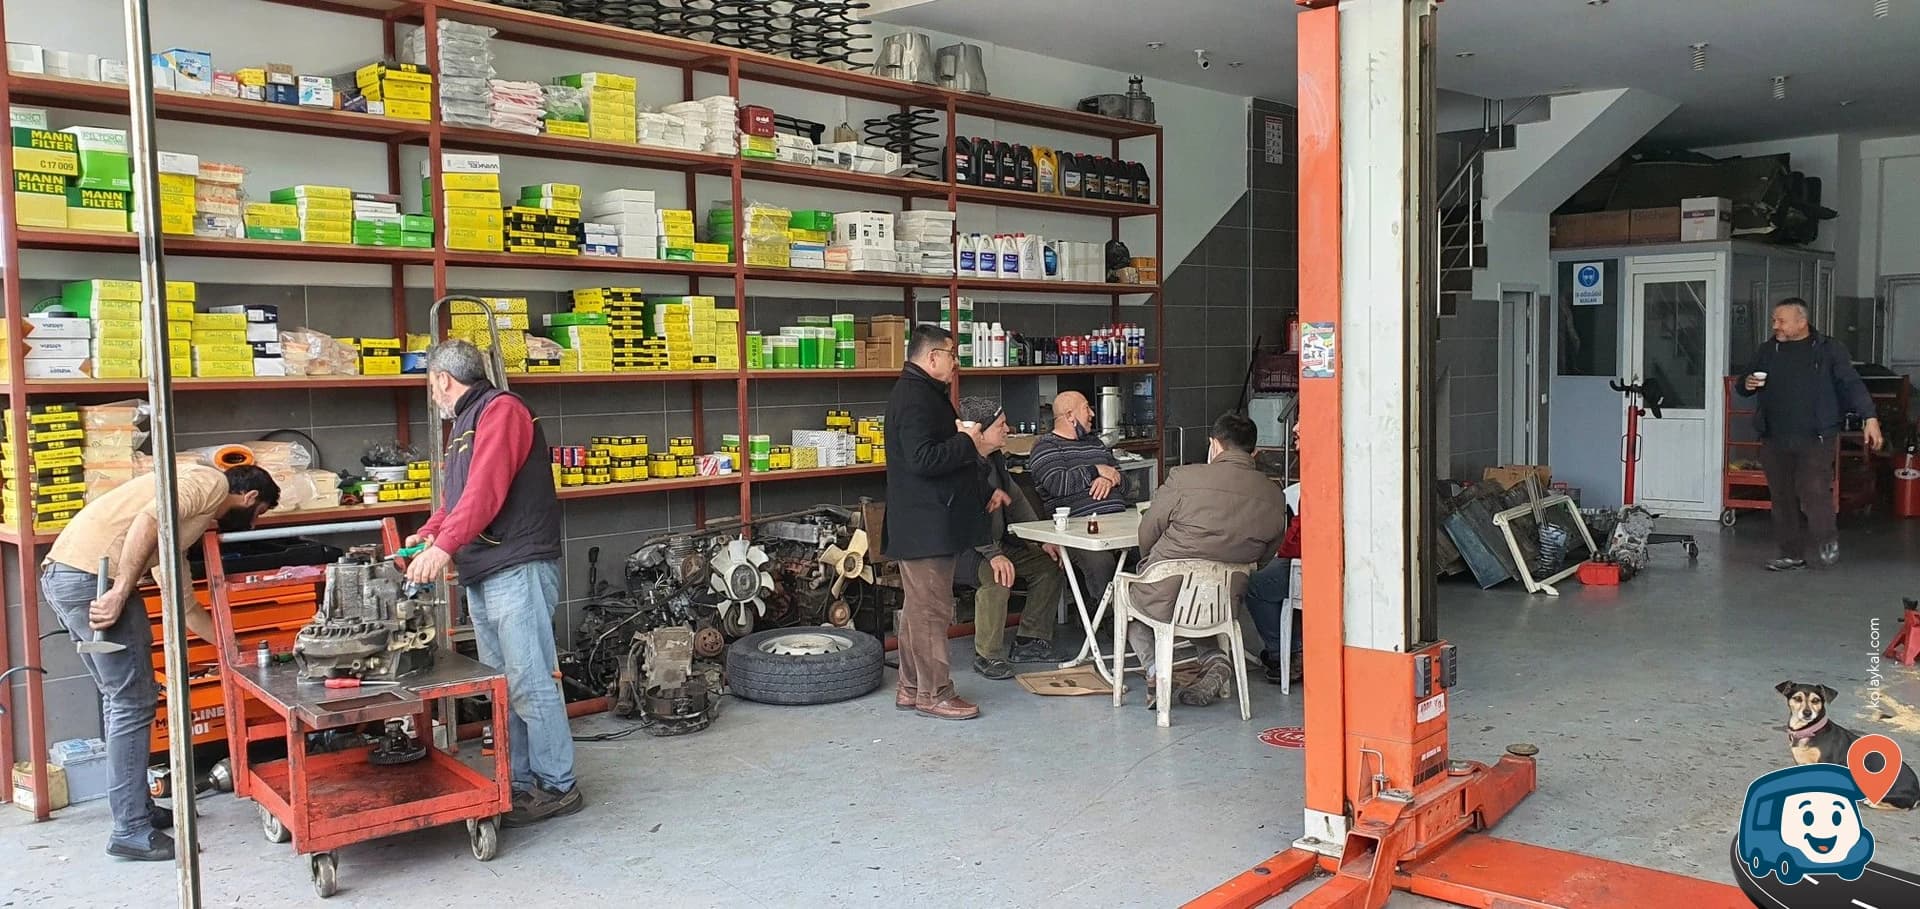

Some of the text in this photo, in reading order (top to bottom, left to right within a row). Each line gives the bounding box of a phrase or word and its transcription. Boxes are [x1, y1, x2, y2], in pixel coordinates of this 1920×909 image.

[31, 130, 73, 142] MANN
[31, 139, 73, 151] FILTER
[40, 160, 74, 170] C 17 009
[18, 172, 64, 185] MANN
[19, 181, 65, 193] FILTER
[82, 190, 123, 201] MANN
[82, 198, 124, 209] FILTER
